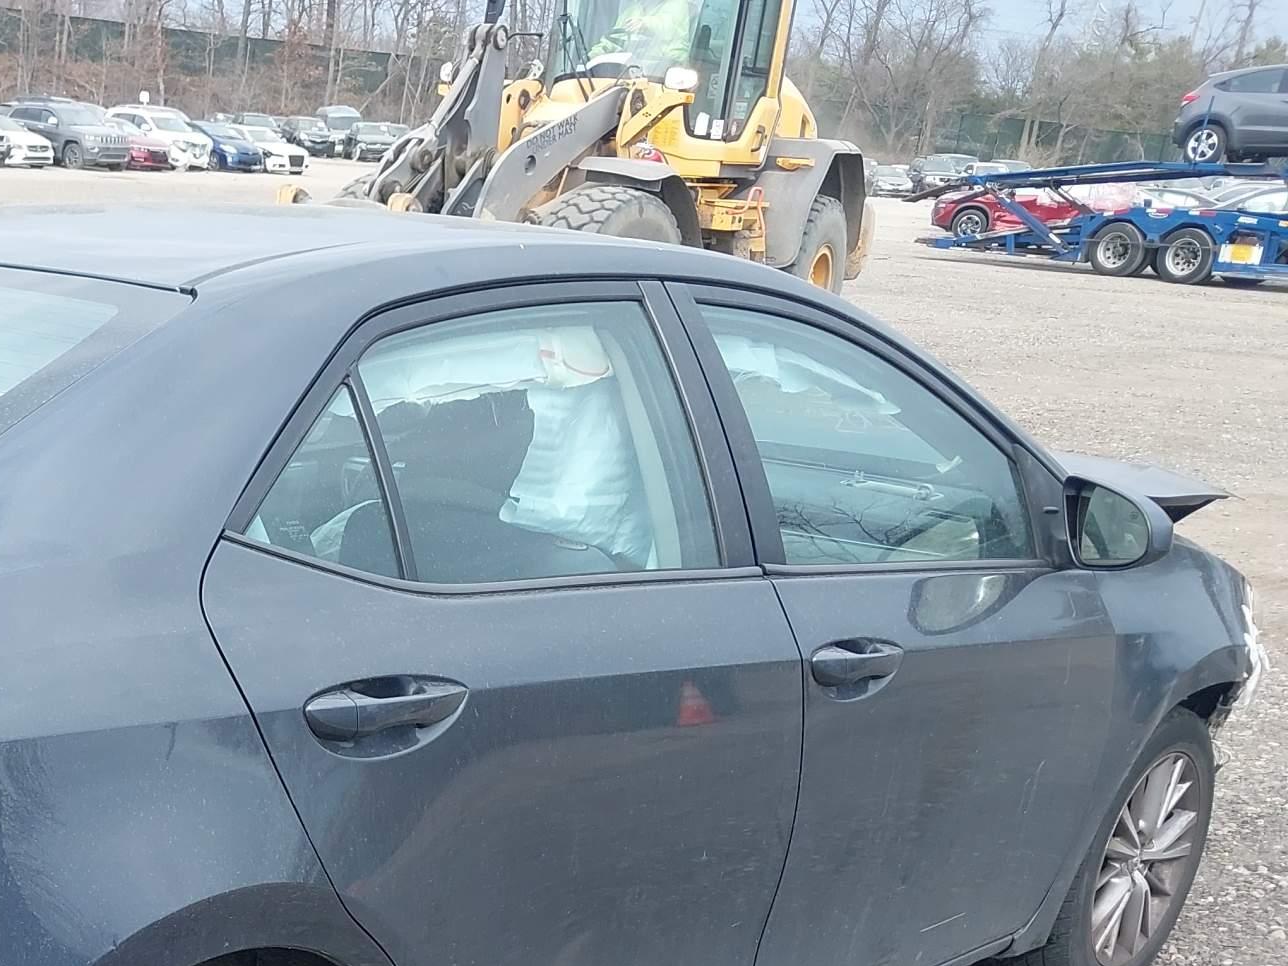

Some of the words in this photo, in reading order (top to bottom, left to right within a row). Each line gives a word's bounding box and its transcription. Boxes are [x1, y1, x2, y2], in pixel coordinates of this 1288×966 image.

[539, 125, 556, 143] NOT
[557, 112, 579, 131] WALK
[558, 123, 577, 140] MAST
